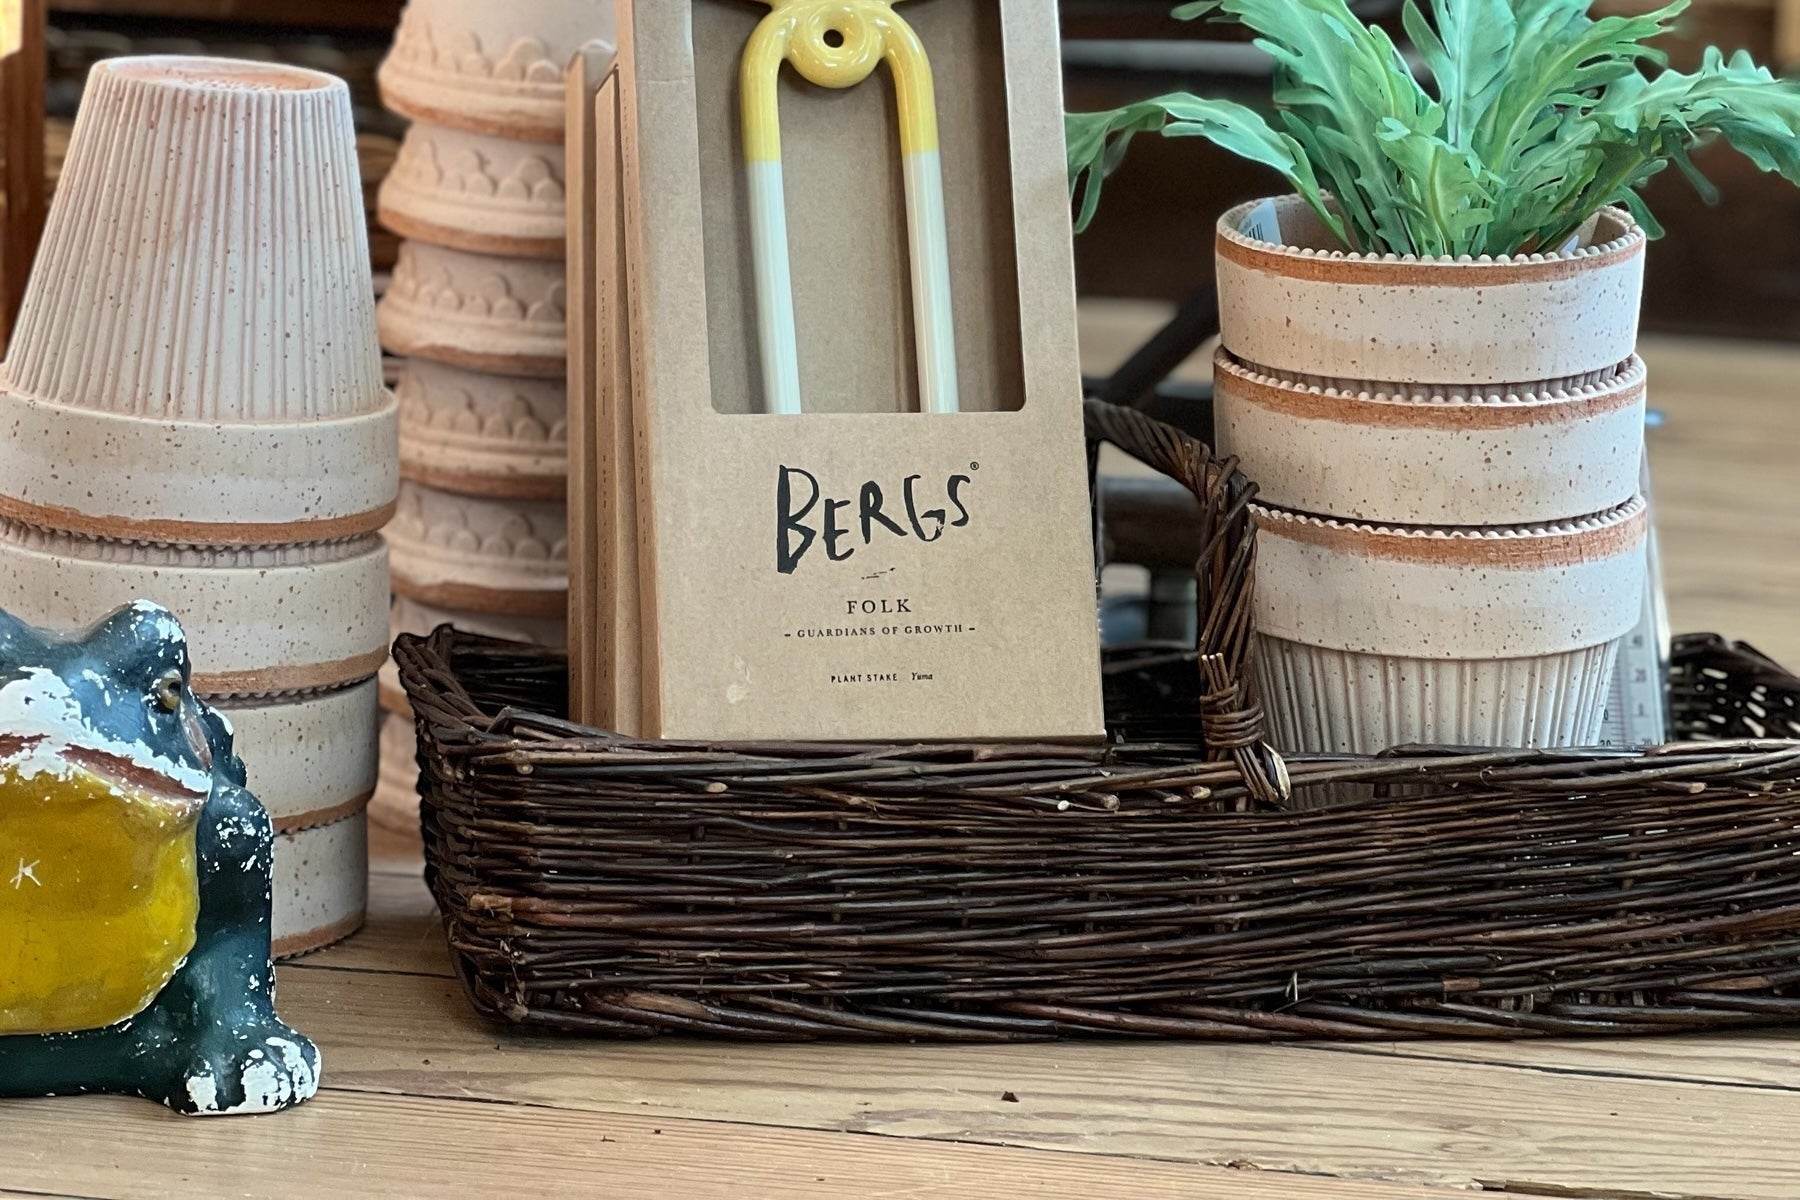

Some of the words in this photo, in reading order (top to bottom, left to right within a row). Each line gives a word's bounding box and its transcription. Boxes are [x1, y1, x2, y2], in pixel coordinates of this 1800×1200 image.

[776, 464, 971, 575] BERGS
[846, 598, 912, 615] FOLK
[796, 626, 876, 638] GUARDIANS
[881, 625, 899, 635] OF
[904, 623, 963, 635] GROWTH
[830, 674, 863, 683] PLANT
[866, 672, 898, 682] STAKE
[911, 671, 933, 681] Yuma
